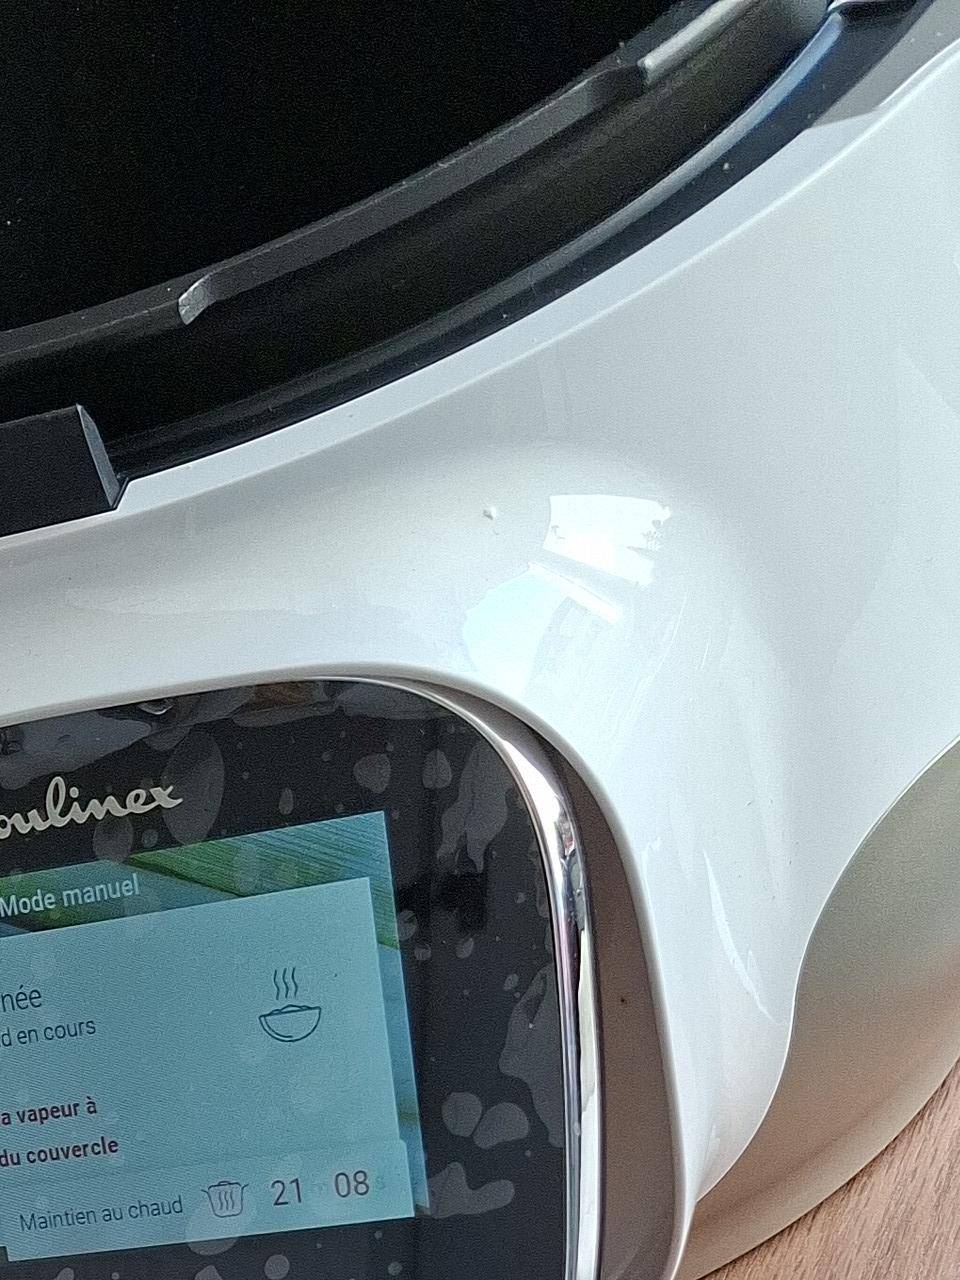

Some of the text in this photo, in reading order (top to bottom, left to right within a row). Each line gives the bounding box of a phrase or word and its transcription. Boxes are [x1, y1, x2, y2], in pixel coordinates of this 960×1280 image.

[62, 873, 140, 908] manuel
[17, 1028, 39, 1045] en
[43, 1019, 96, 1041] cours
[16, 1101, 80, 1125] vapeur
[86, 1096, 97, 1115] à
[26, 1136, 119, 1163] couvercle
[19, 1206, 96, 1232] Maintien
[102, 1206, 124, 1221] au
[128, 1195, 184, 1219] chaud
[270, 1177, 303, 1207] 21
[334, 1170, 370, 1198] 08
